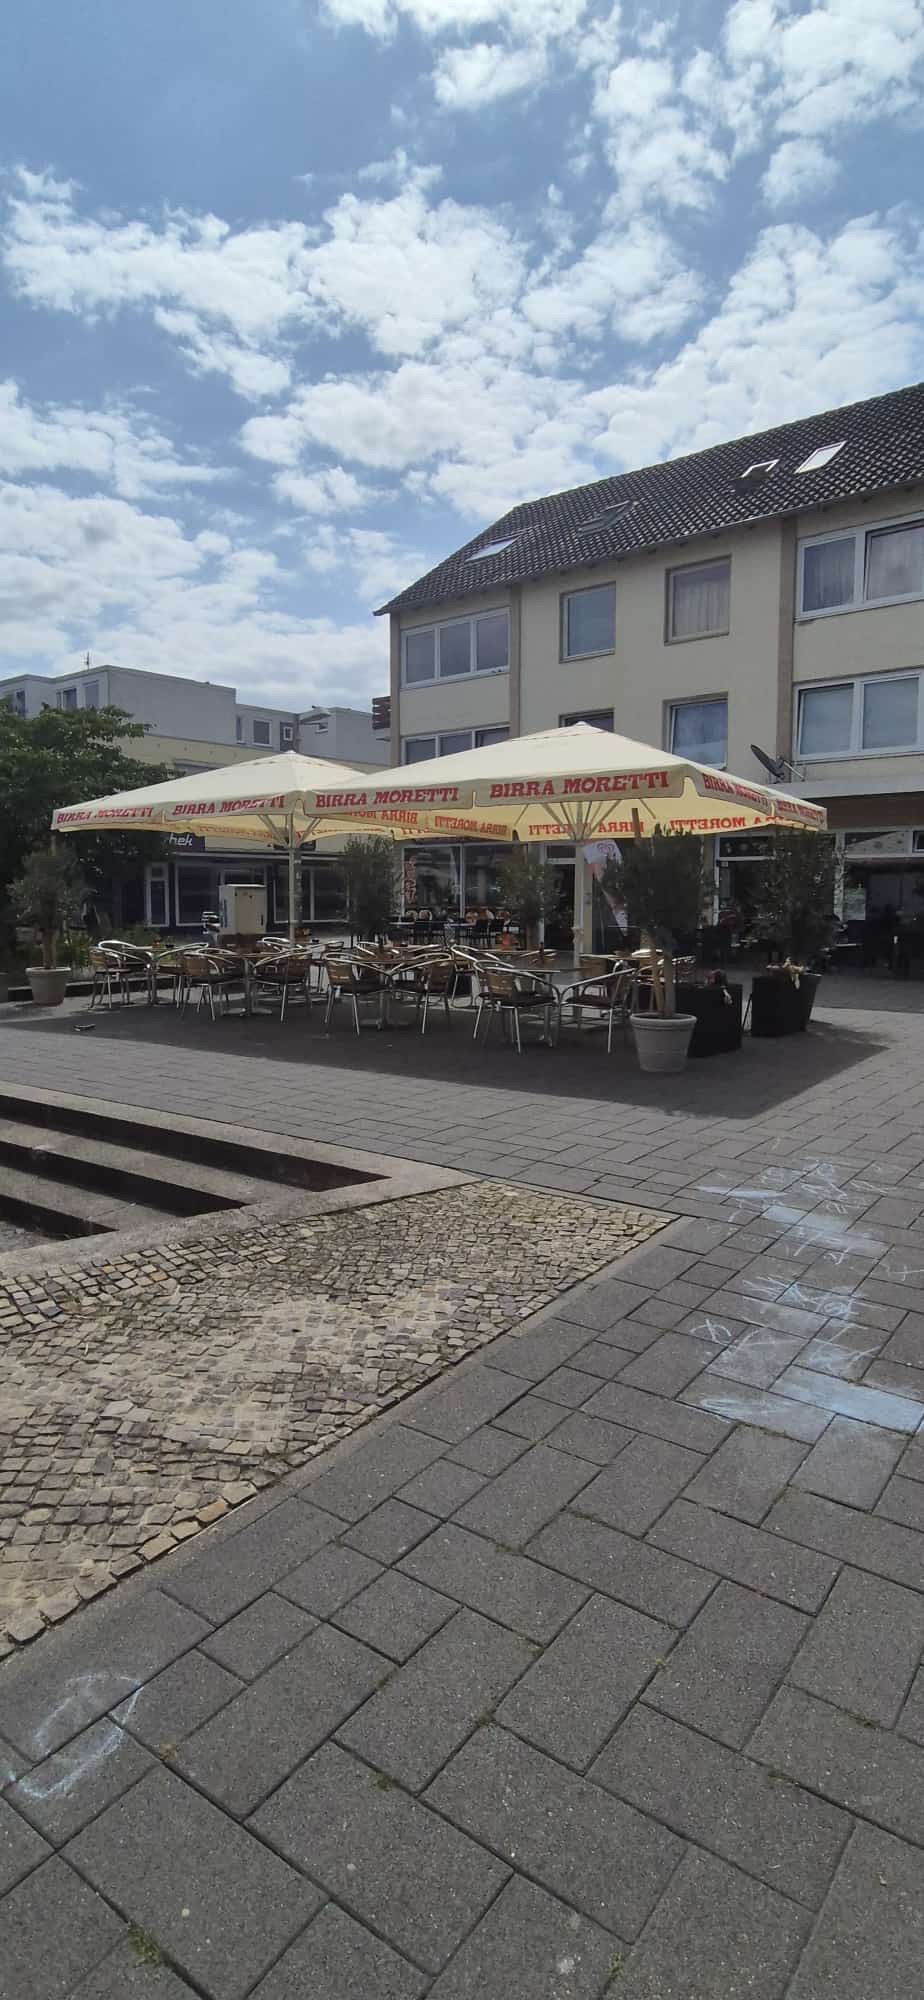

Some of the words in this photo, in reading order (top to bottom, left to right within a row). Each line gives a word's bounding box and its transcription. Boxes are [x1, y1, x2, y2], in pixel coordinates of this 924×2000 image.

[490, 780, 555, 798] BIRRA
[562, 771, 669, 794] MORETTI
[316, 793, 367, 808] BIRRA
[373, 787, 459, 805] MORETTI
[172, 802, 215, 815] BIRRA
[169, 832, 193, 846] hek
